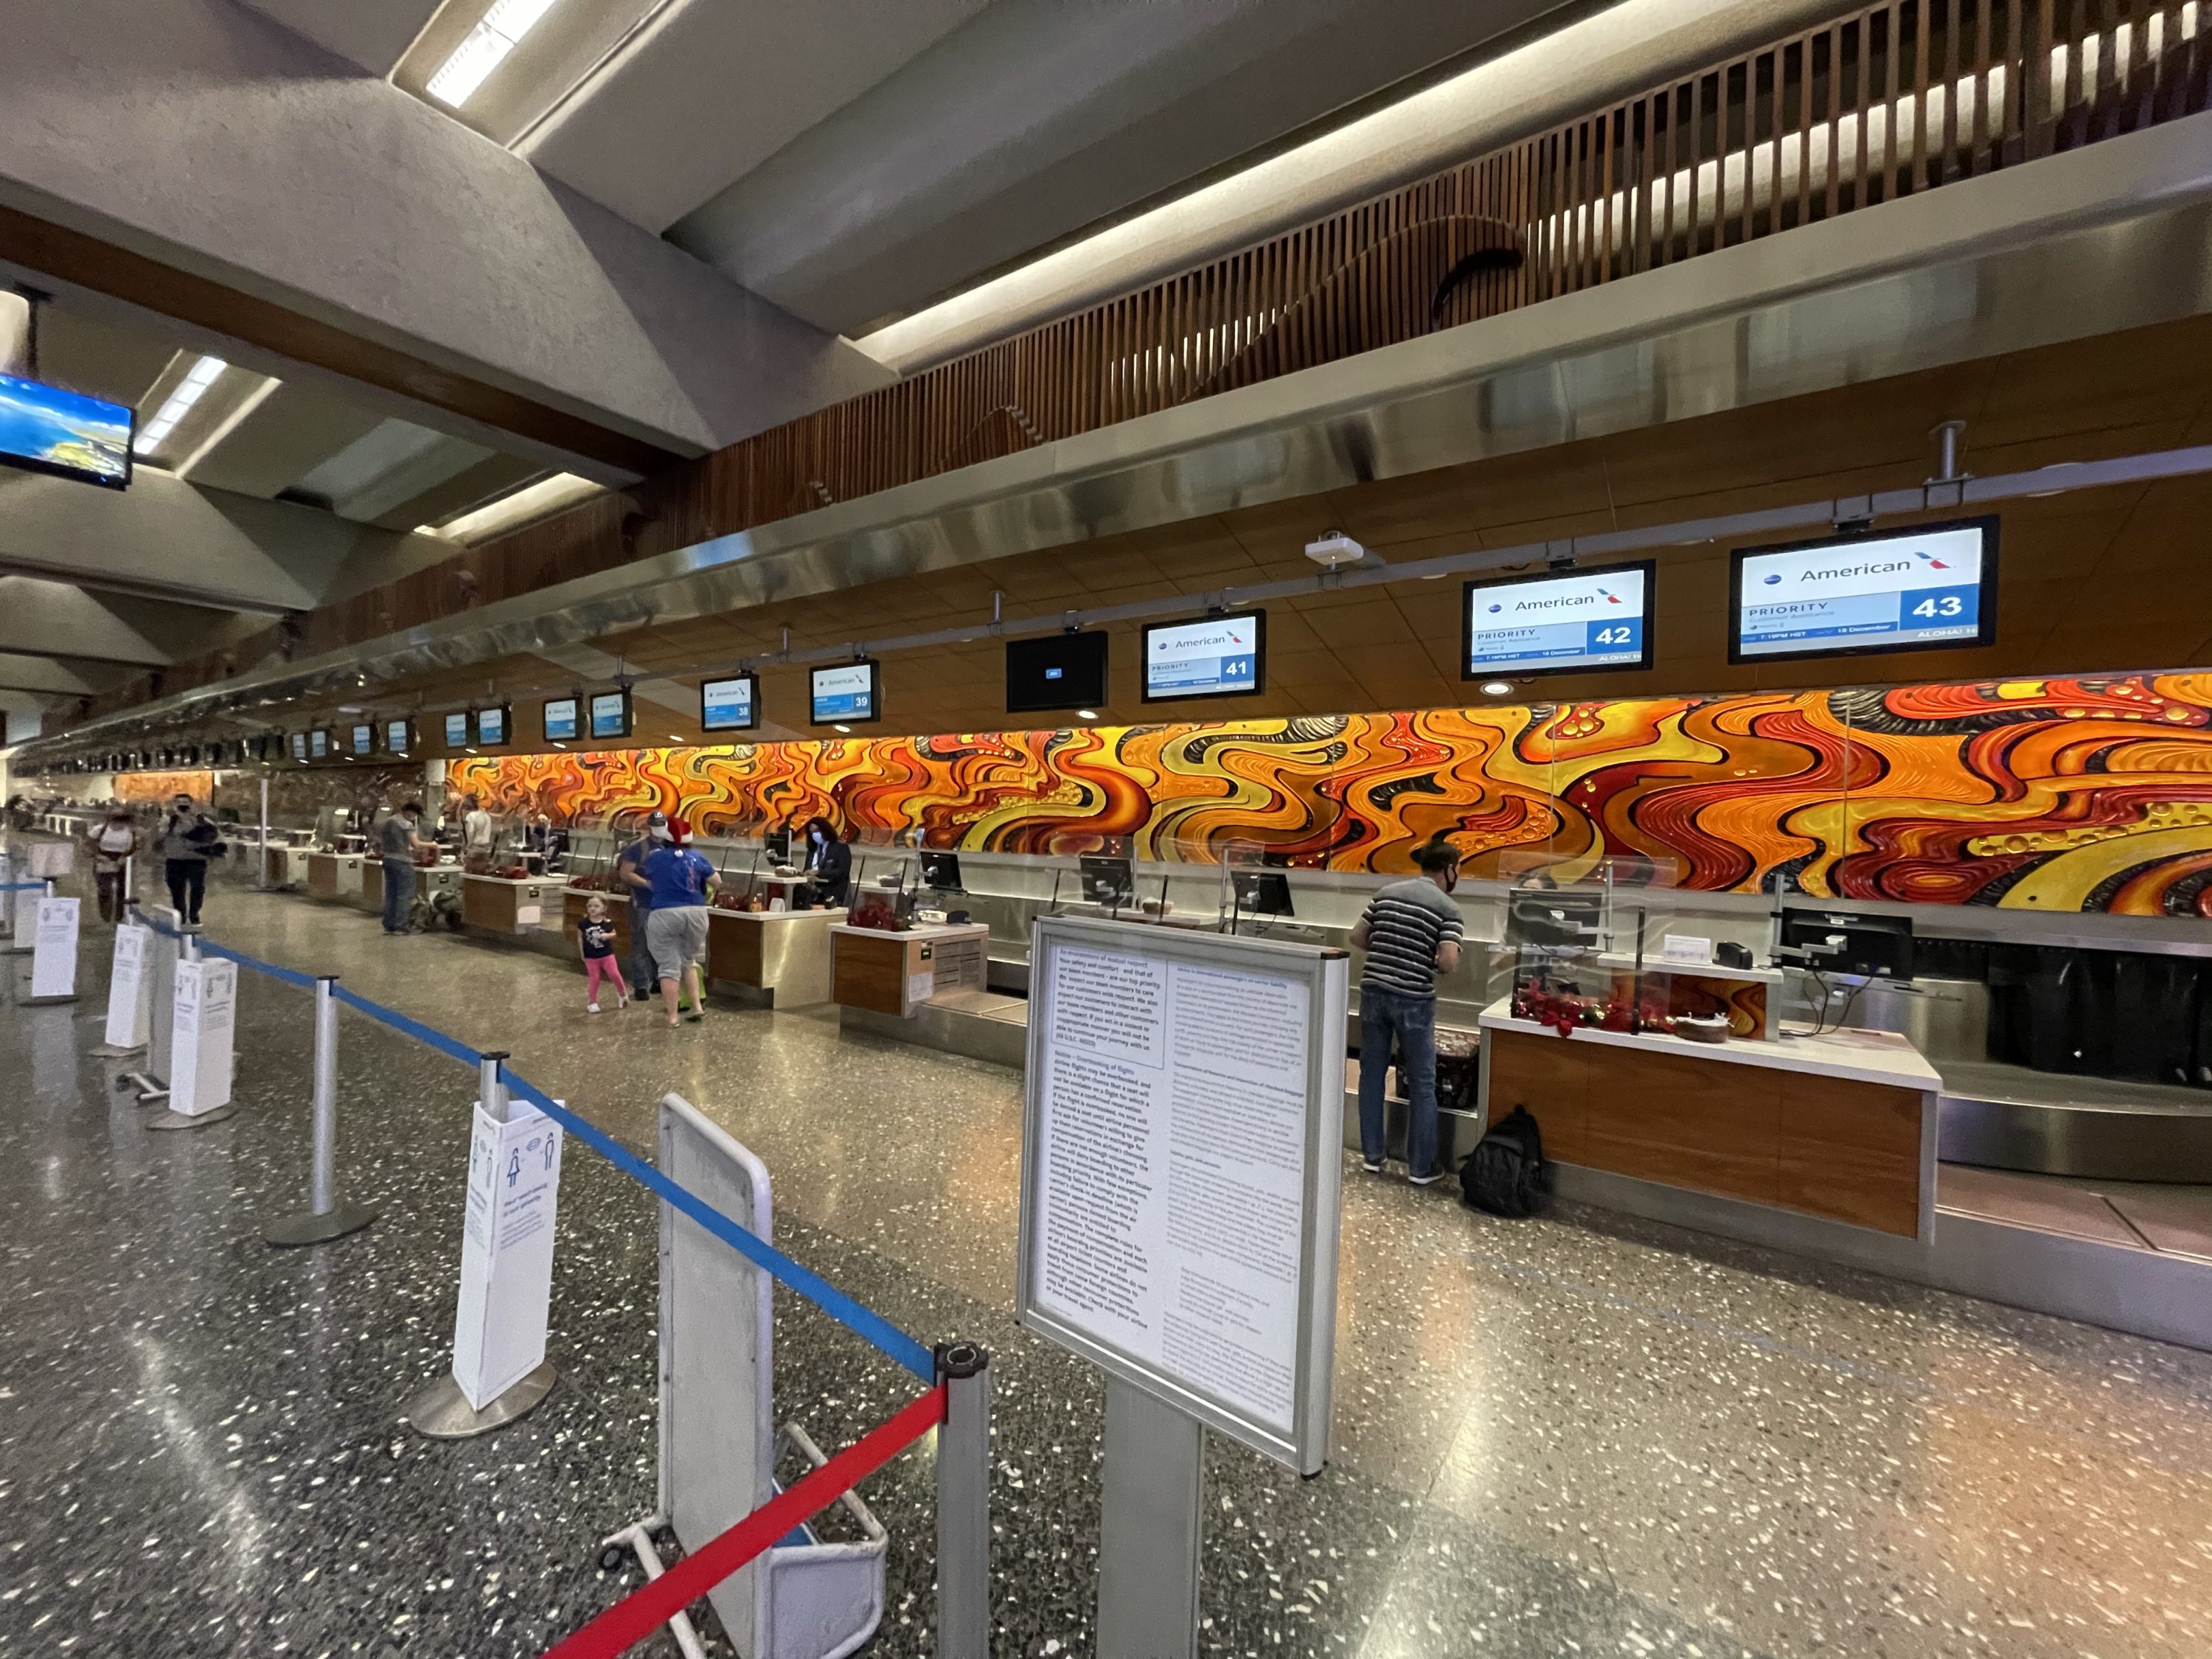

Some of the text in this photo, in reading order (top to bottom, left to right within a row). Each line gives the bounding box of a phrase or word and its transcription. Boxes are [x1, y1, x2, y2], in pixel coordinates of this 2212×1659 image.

[1801, 561, 1910, 581] American
[1515, 596, 1594, 611] American
[1750, 602, 1828, 616] PRIORITY
[1913, 597, 1962, 617] 43
[1478, 629, 1536, 640] PRIORITY
[1596, 627, 1631, 644] 42
[1175, 636, 1225, 648] American
[1152, 663, 1189, 671] PRIORITY
[1225, 661, 1246, 675] 41
[855, 696, 868, 707] 39
